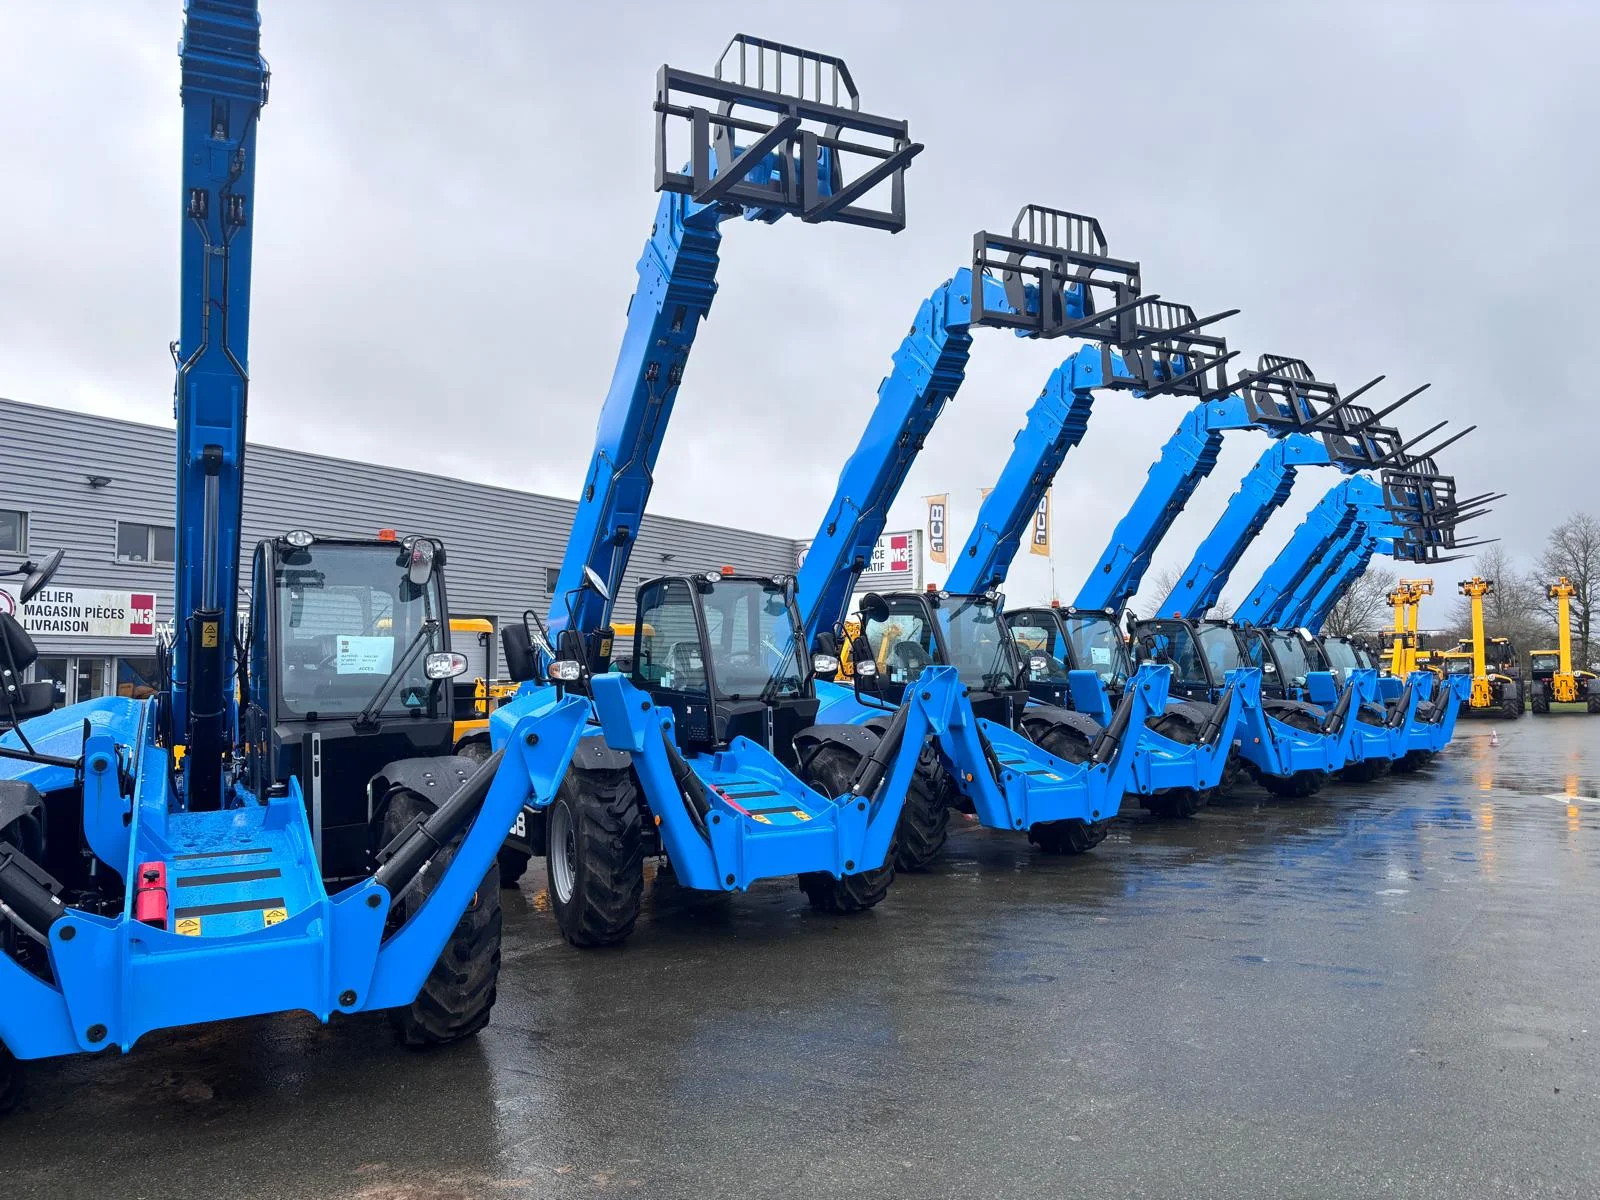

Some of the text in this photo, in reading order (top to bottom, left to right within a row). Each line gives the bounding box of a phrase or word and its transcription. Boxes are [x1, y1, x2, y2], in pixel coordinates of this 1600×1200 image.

[930, 504, 944, 552] JCB
[892, 548, 907, 562] M3
[24, 604, 125, 620] MAGASIN PIÈCES
[131, 608, 154, 625] M3
[23, 619, 89, 632] LIVRAISON
